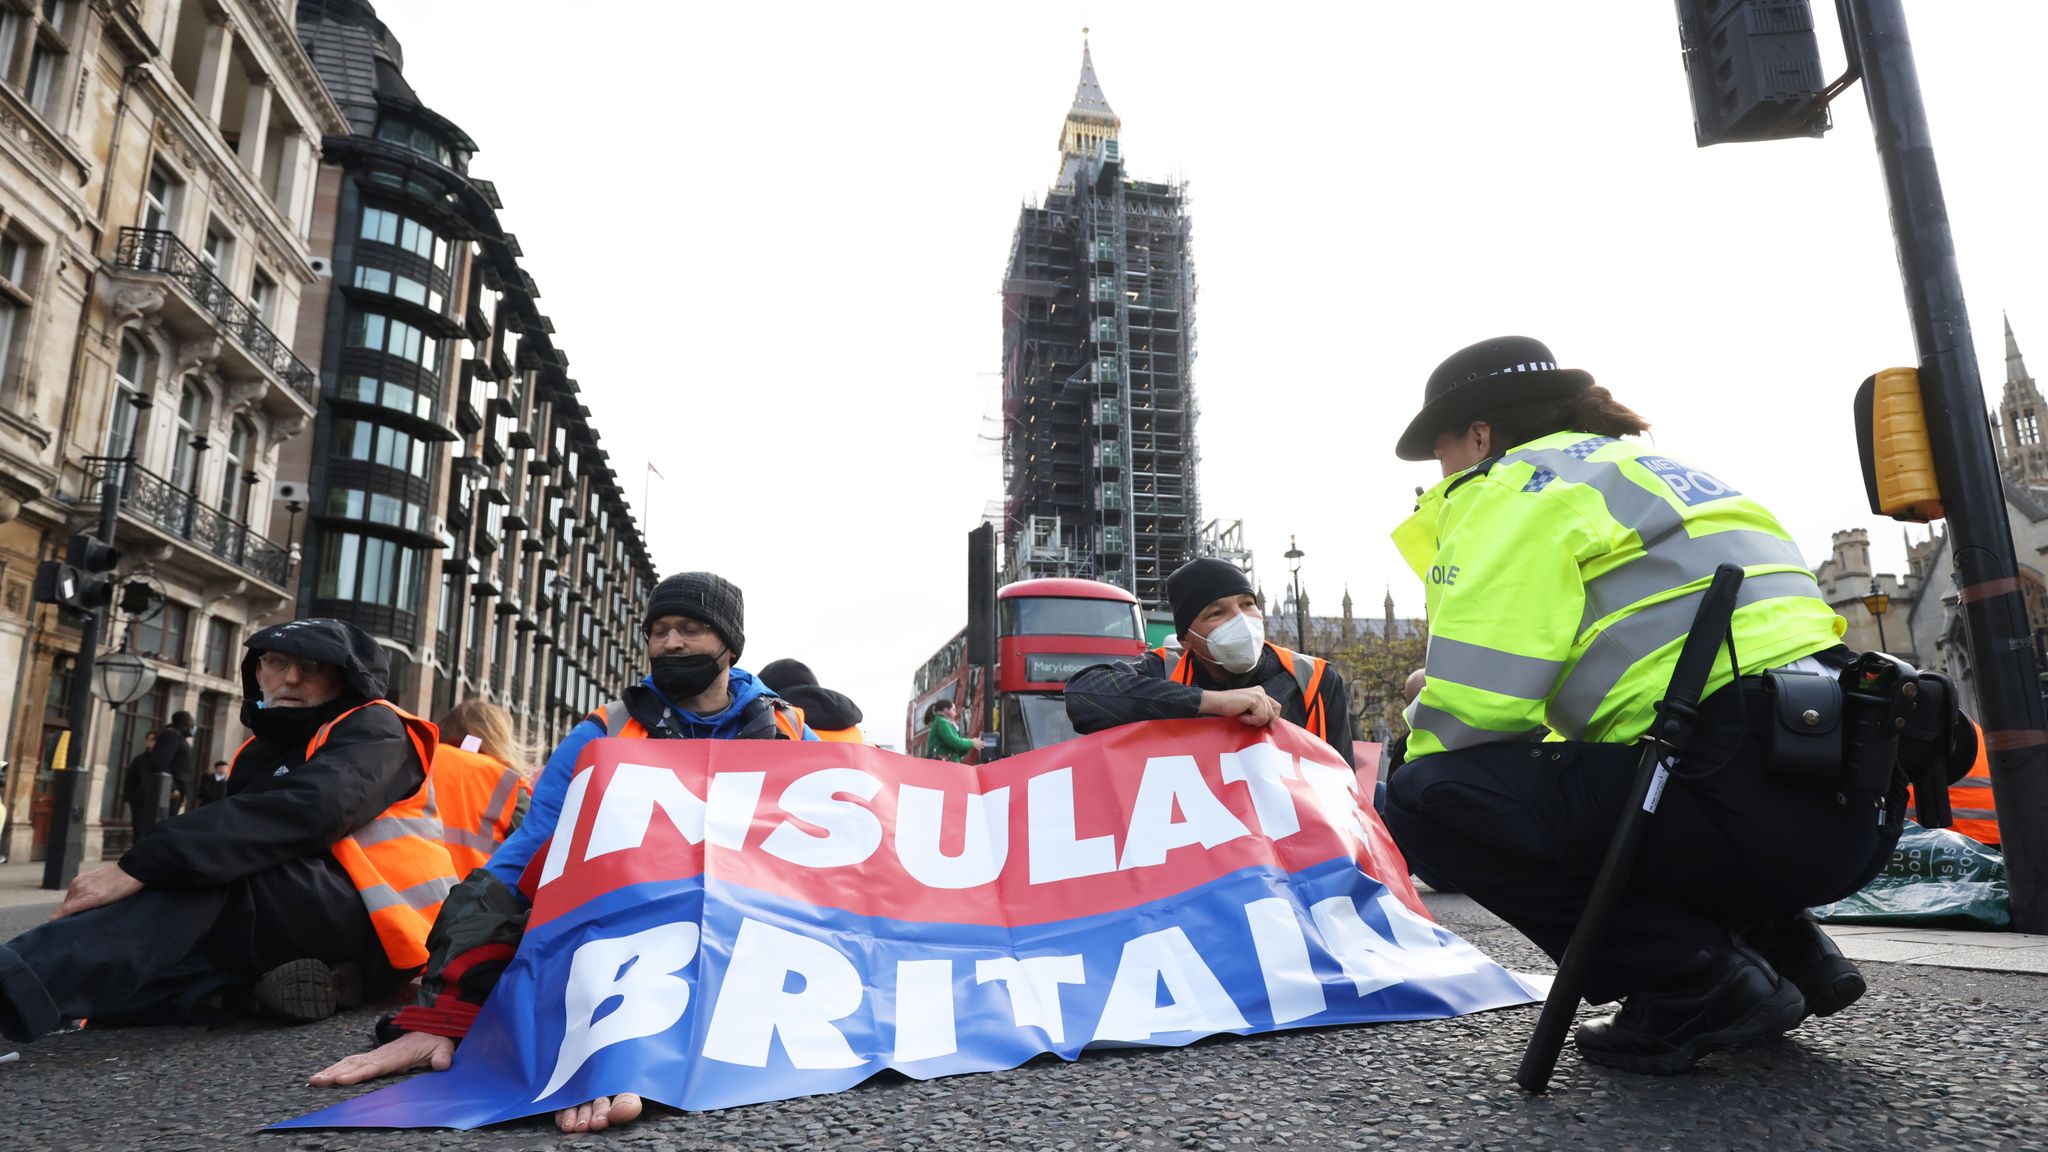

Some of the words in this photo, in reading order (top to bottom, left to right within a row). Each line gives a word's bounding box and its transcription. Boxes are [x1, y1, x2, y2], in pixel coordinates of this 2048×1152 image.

[538, 742, 1373, 889] INSULATE
[1958, 846, 1975, 876] FOO
[532, 896, 1477, 1103] BRITAIN
